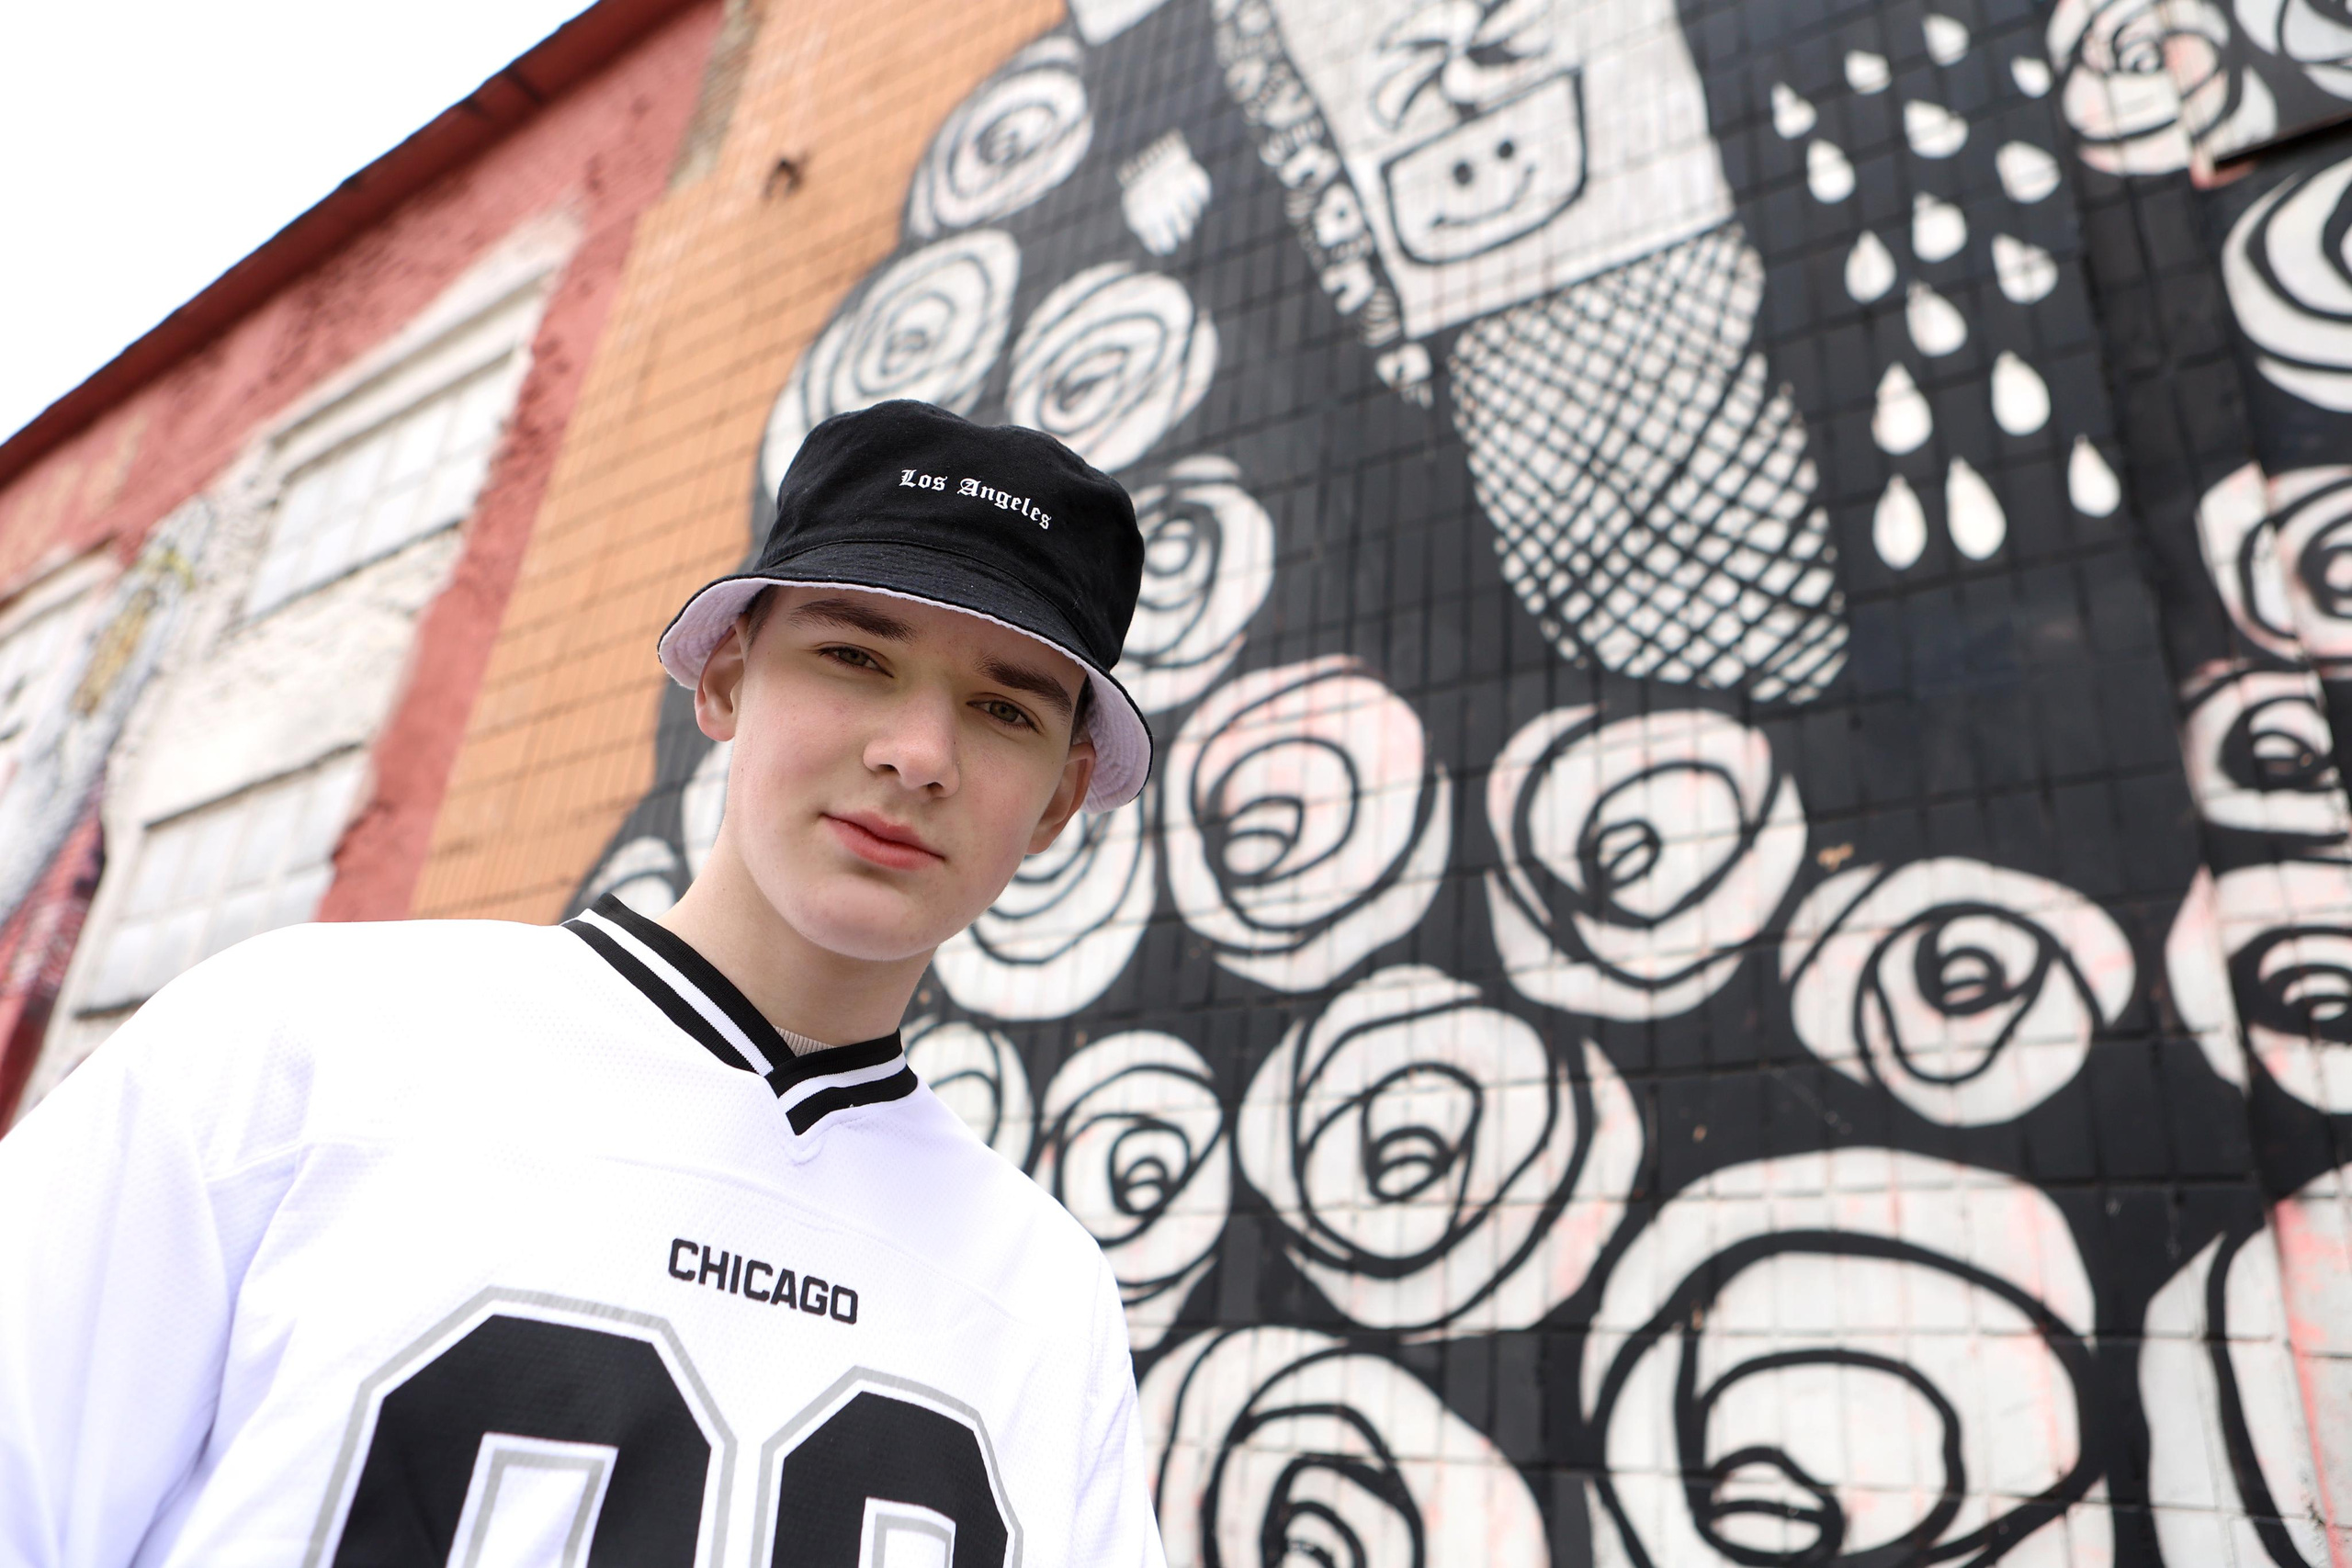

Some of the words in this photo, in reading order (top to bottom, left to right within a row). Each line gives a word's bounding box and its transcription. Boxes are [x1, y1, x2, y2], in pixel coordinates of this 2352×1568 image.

[899, 468, 948, 491] Los
[956, 478, 1052, 530] Angeles
[668, 1238, 858, 1325] CHICAGO
